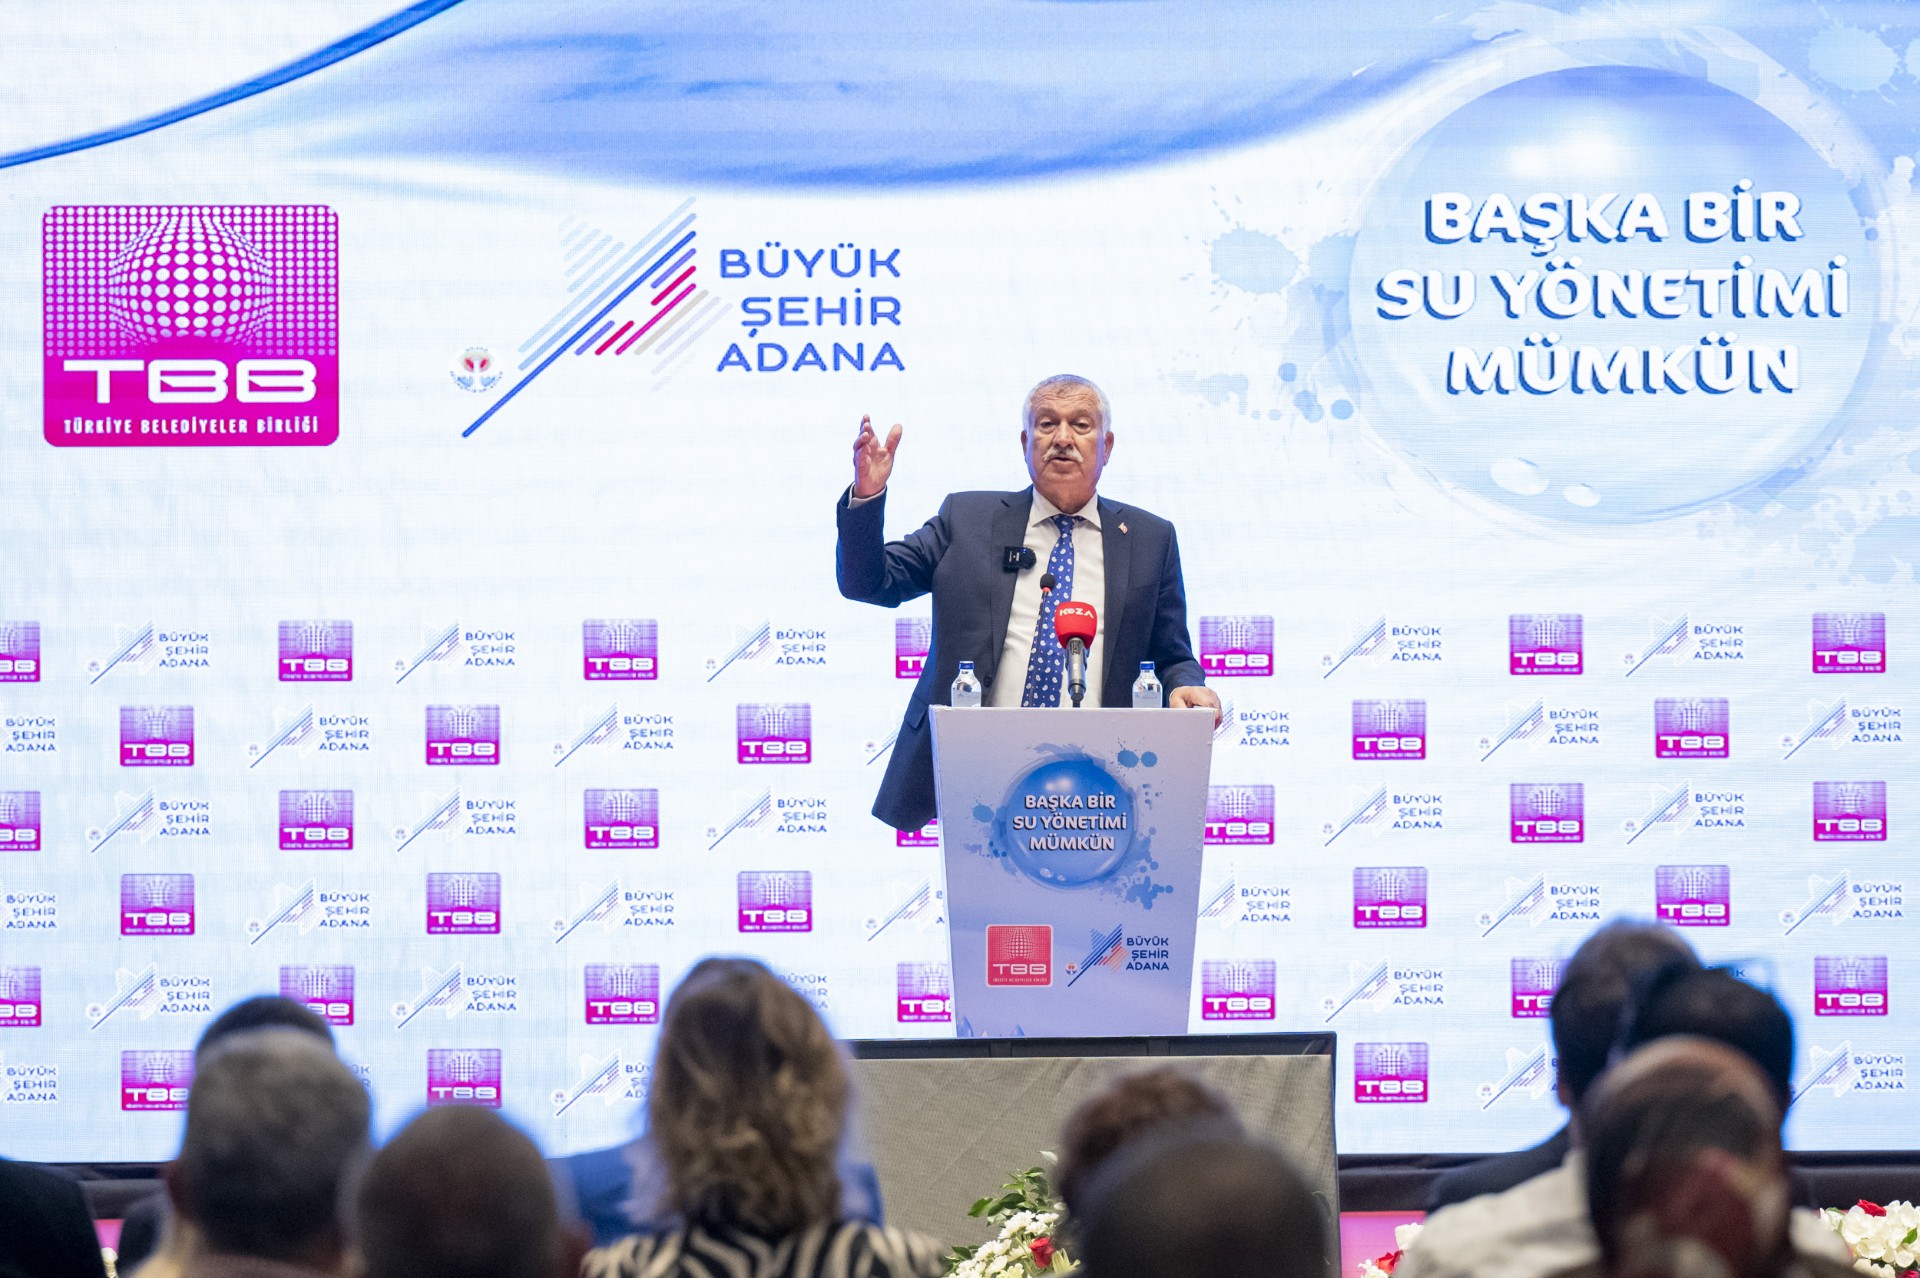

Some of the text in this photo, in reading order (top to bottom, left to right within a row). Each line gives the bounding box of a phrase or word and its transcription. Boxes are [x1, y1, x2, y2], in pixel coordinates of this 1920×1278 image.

[1425, 178, 1804, 257] BAŞKA BİR
[719, 241, 901, 278] BÜYÜK
[1376, 254, 1849, 320] SU YÖNETİMİ
[740, 288, 902, 338] ŞEHİR
[716, 342, 906, 373] ADANA
[1446, 331, 1799, 394] MÜMKÜN
[63, 359, 317, 404] TBB
[64, 415, 319, 434] TÜRKİYE BELEDİYELER BİRLİĞİ
[1059, 607, 1094, 619] KOZA
[1204, 655, 1268, 666] TBB
[1514, 653, 1578, 665] TBB
[1817, 651, 1881, 663] TBB
[283, 659, 348, 671] TBB
[589, 658, 653, 670] TBB
[743, 742, 806, 753] TBB
[1357, 738, 1421, 750] TBB
[1660, 736, 1724, 748] TBB
[125, 744, 189, 756] TBB
[431, 743, 495, 755] TBB
[1025, 791, 1116, 812] BAŞKA BİR
[1013, 811, 1127, 830] SU YÖNETİMİ
[1818, 820, 1882, 831] TBB
[590, 827, 654, 838] TBB
[1207, 823, 1269, 835] TBB
[1515, 821, 1579, 833] TBB
[284, 828, 348, 840] TBB
[1030, 832, 1115, 850] MÜMKÜN
[743, 910, 807, 922] TBB
[1358, 906, 1422, 918] TBB
[1661, 905, 1725, 916] TBB
[126, 913, 190, 925] TBB
[431, 912, 495, 924] TBB
[1126, 935, 1169, 946] BÜYÜK
[1131, 948, 1169, 962] ŞEHİR
[992, 963, 1047, 975] TBB
[1126, 962, 1170, 971] ADANA
[1206, 998, 1270, 1010] TBB
[1819, 994, 1883, 1006] TBB
[590, 1002, 654, 1014] TBB
[432, 1087, 496, 1098] TBB
[1359, 1081, 1423, 1093] TBB
[126, 1088, 188, 1101] TBB
